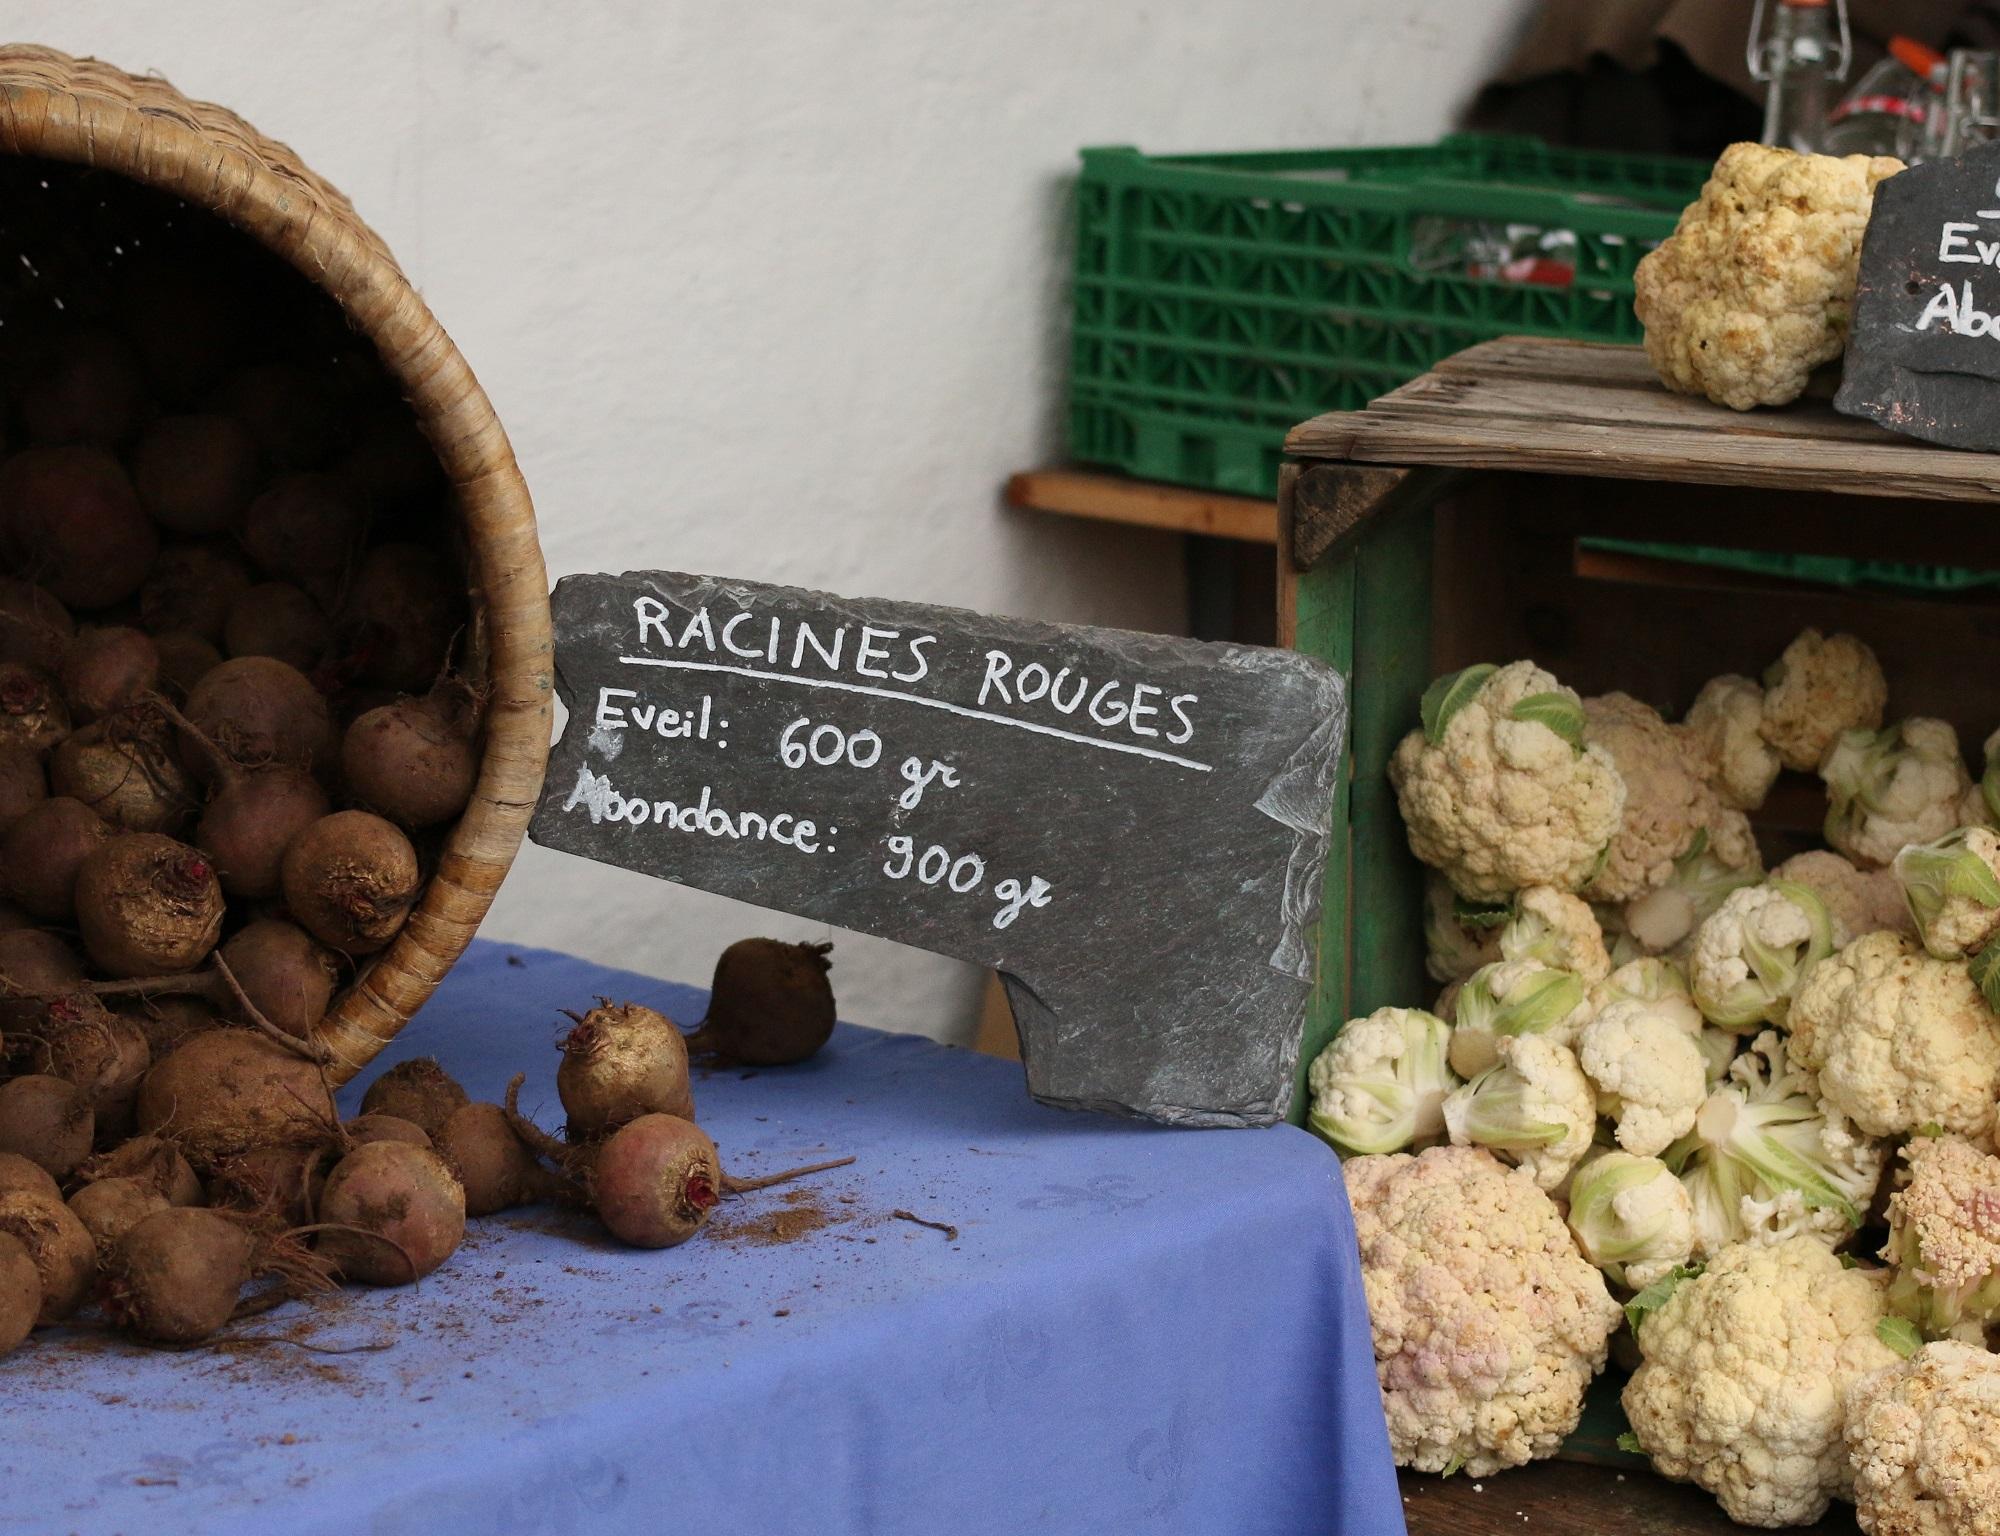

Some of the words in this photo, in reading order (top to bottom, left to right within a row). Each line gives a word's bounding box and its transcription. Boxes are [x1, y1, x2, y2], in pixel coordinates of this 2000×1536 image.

[1940, 222, 2000, 266] Ev
[633, 597, 937, 683] RACINES
[978, 651, 1198, 744] ROUGES
[596, 687, 729, 748] Eveil:
[780, 717, 882, 769] 600
[901, 756, 960, 810] gr
[562, 762, 838, 854] Abondance:
[883, 835, 986, 893] 900
